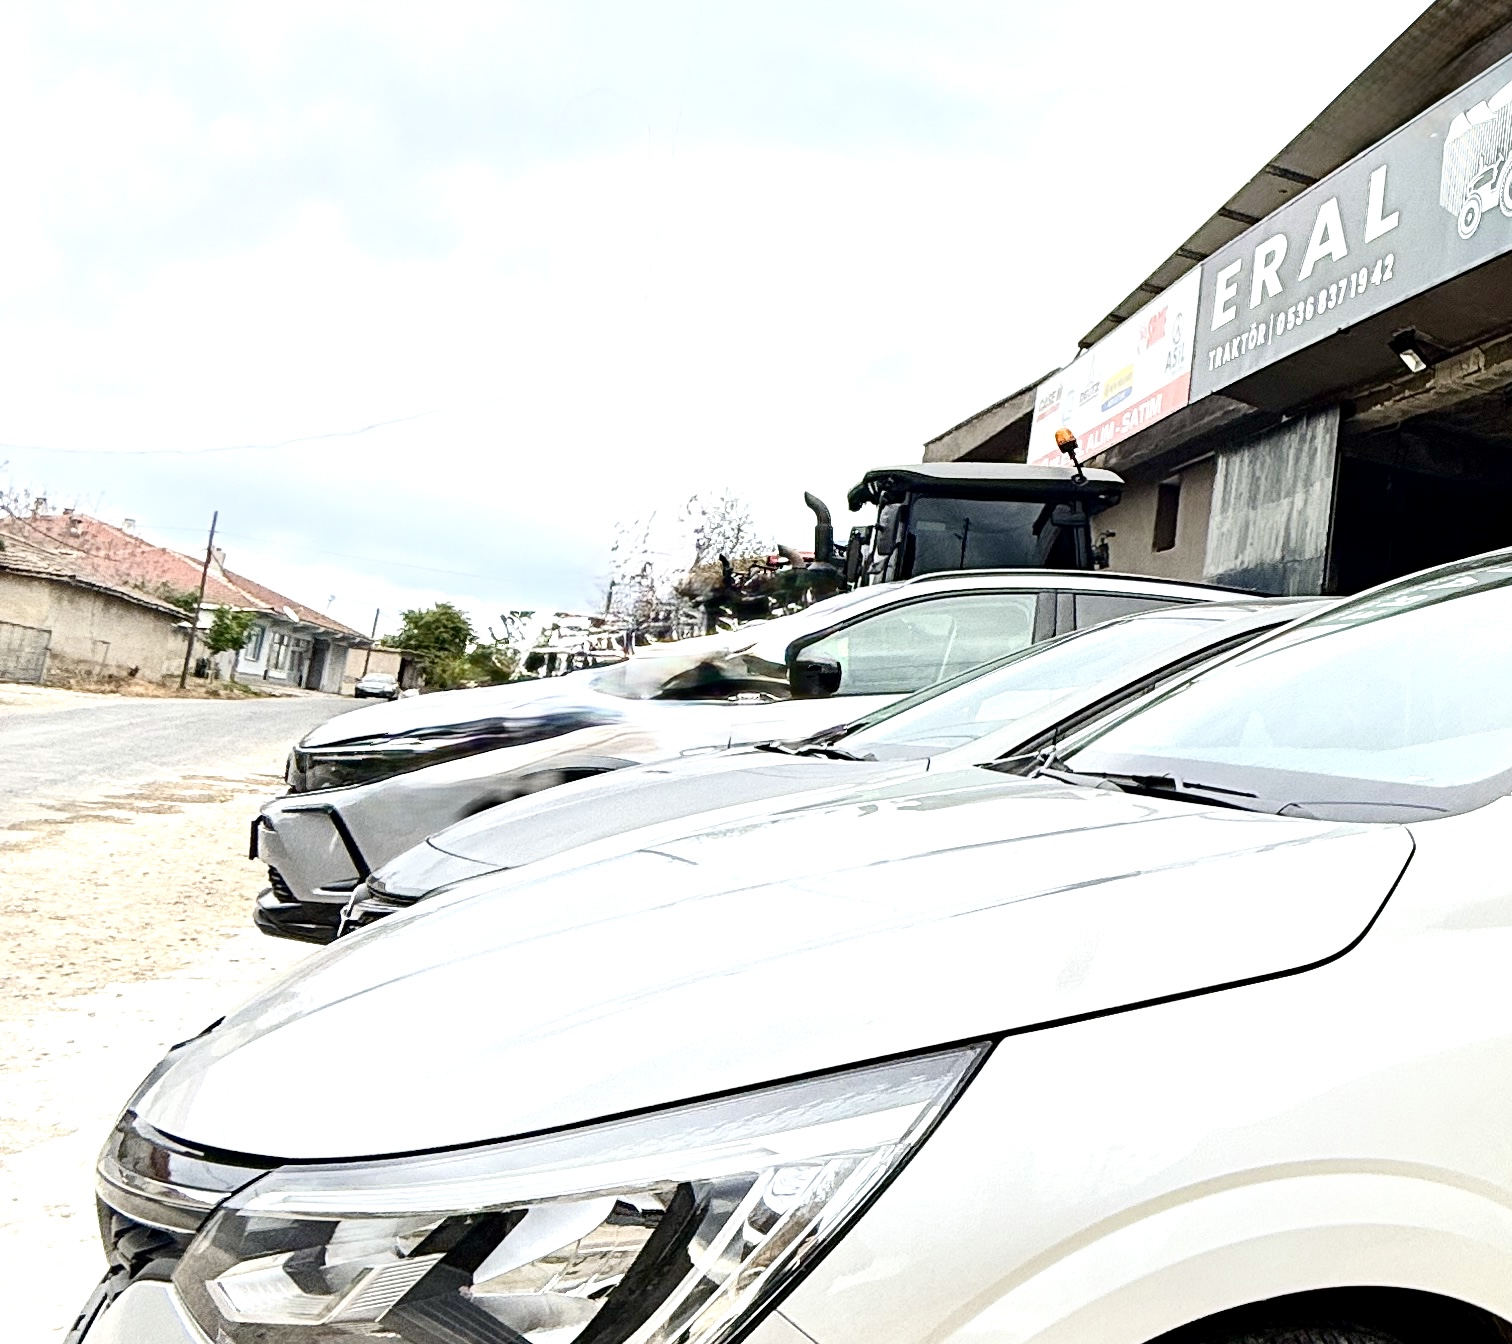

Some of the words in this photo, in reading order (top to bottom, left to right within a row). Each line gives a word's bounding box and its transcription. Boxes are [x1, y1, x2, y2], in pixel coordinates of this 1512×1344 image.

[1210, 164, 1401, 332] ERAL
[1208, 321, 1267, 372] TRAKTÖR
[1121, 394, 1163, 435] SATIM
